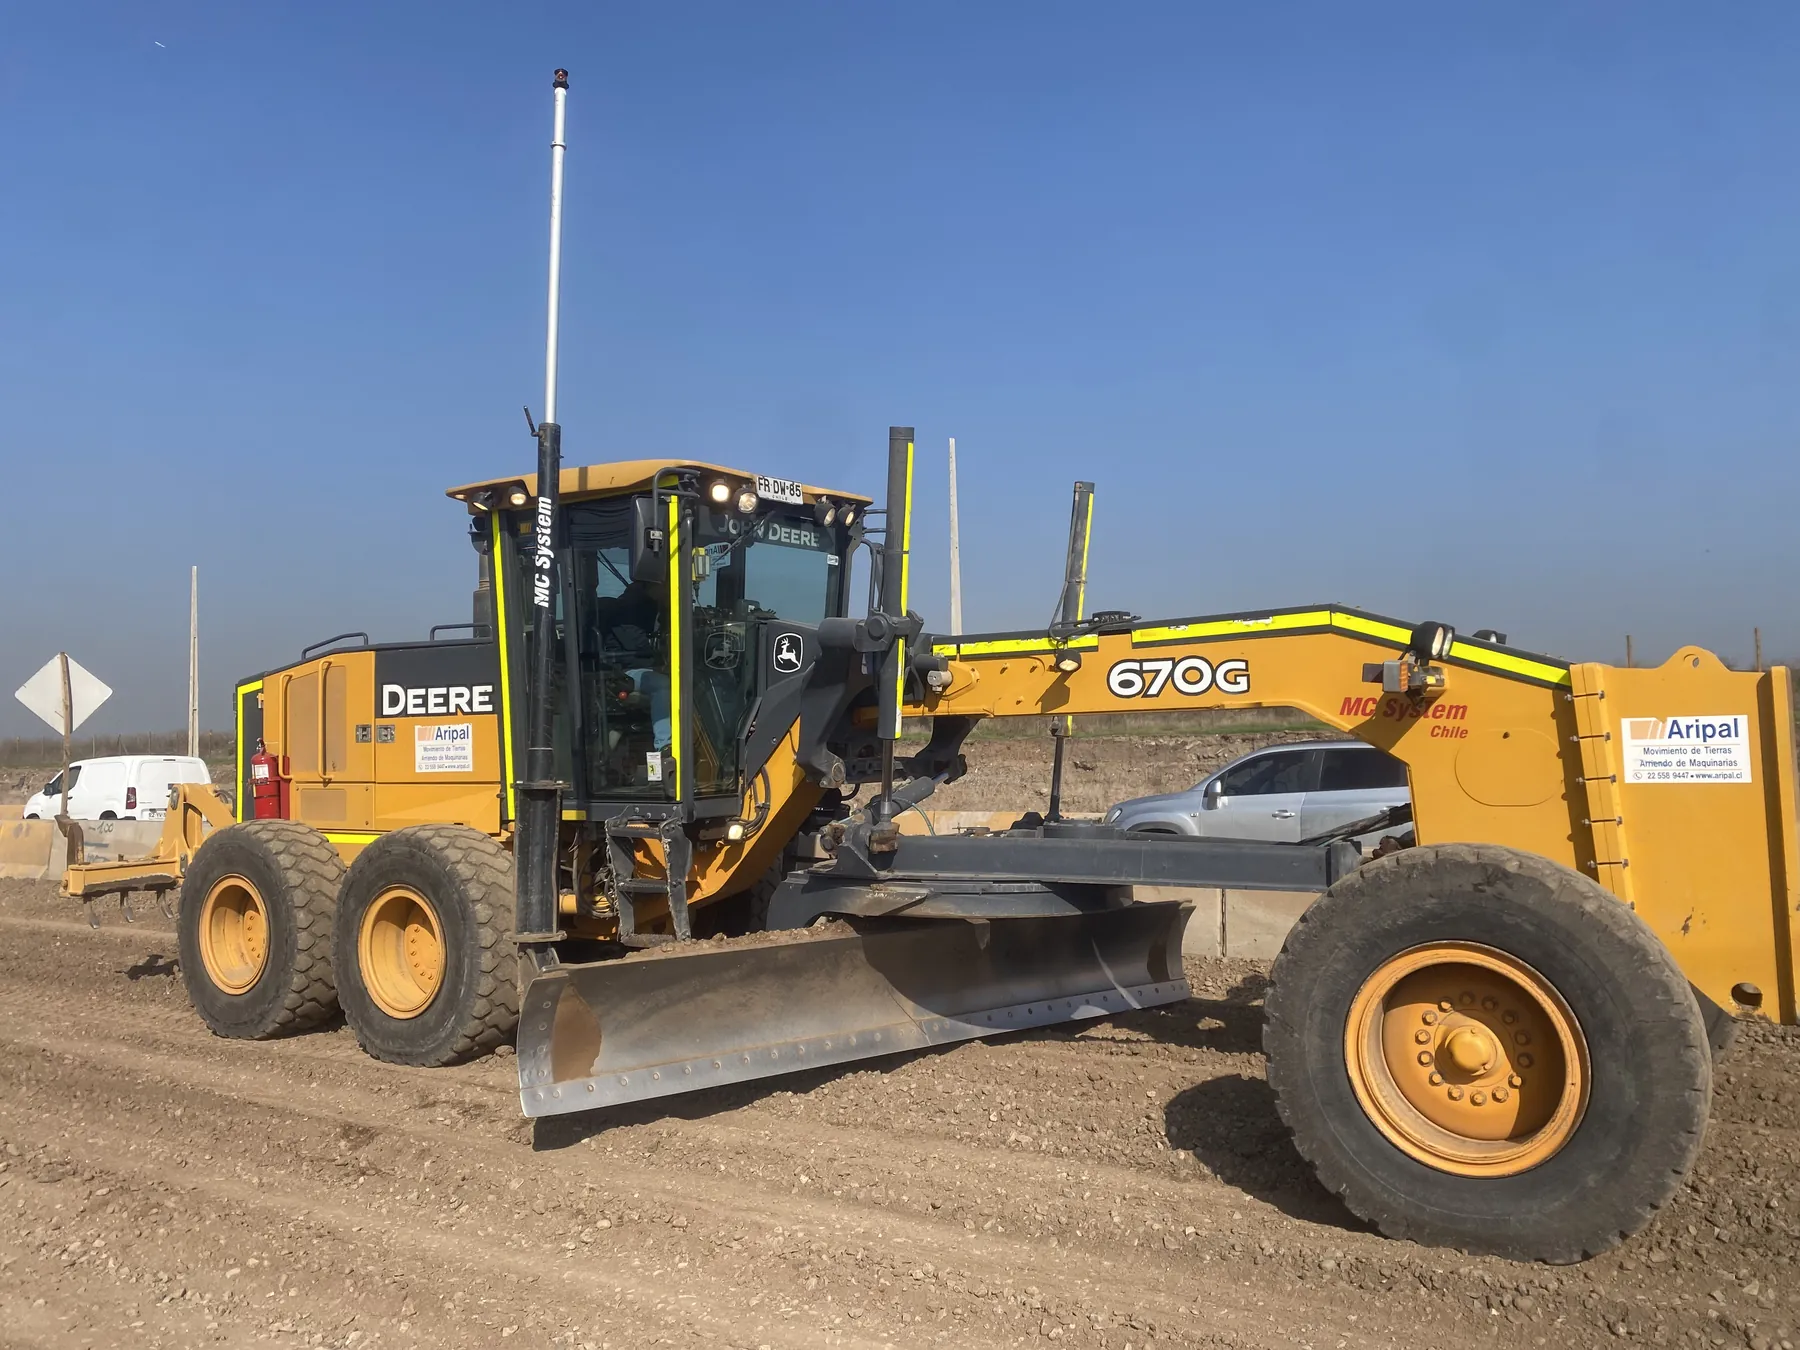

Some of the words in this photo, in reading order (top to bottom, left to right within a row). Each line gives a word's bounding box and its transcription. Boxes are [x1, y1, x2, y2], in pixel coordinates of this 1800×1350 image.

[534, 496, 555, 569] System
[768, 523, 820, 547] DEERE
[534, 573, 550, 608] MC
[1108, 656, 1249, 697] 670G
[382, 684, 493, 716] DEERE
[1340, 697, 1378, 717] MC
[1382, 698, 1468, 722] System
[435, 725, 469, 743] Aripal
[1430, 725, 1468, 739] Chile
[1667, 718, 1739, 743] Aripal
[1643, 747, 1688, 756] Movimiento
[1690, 746, 1701, 755] de
[1704, 746, 1732, 755] Tierras
[1639, 759, 1673, 768] Arriendo
[1675, 759, 1686, 768] de
[1689, 758, 1738, 769] Maquinarias
[1647, 772, 1656, 780] 22
[1657, 772, 1670, 780] 558
[1672, 771, 1690, 780] 9447
[1695, 771, 1743, 780] www.aripal.cl
